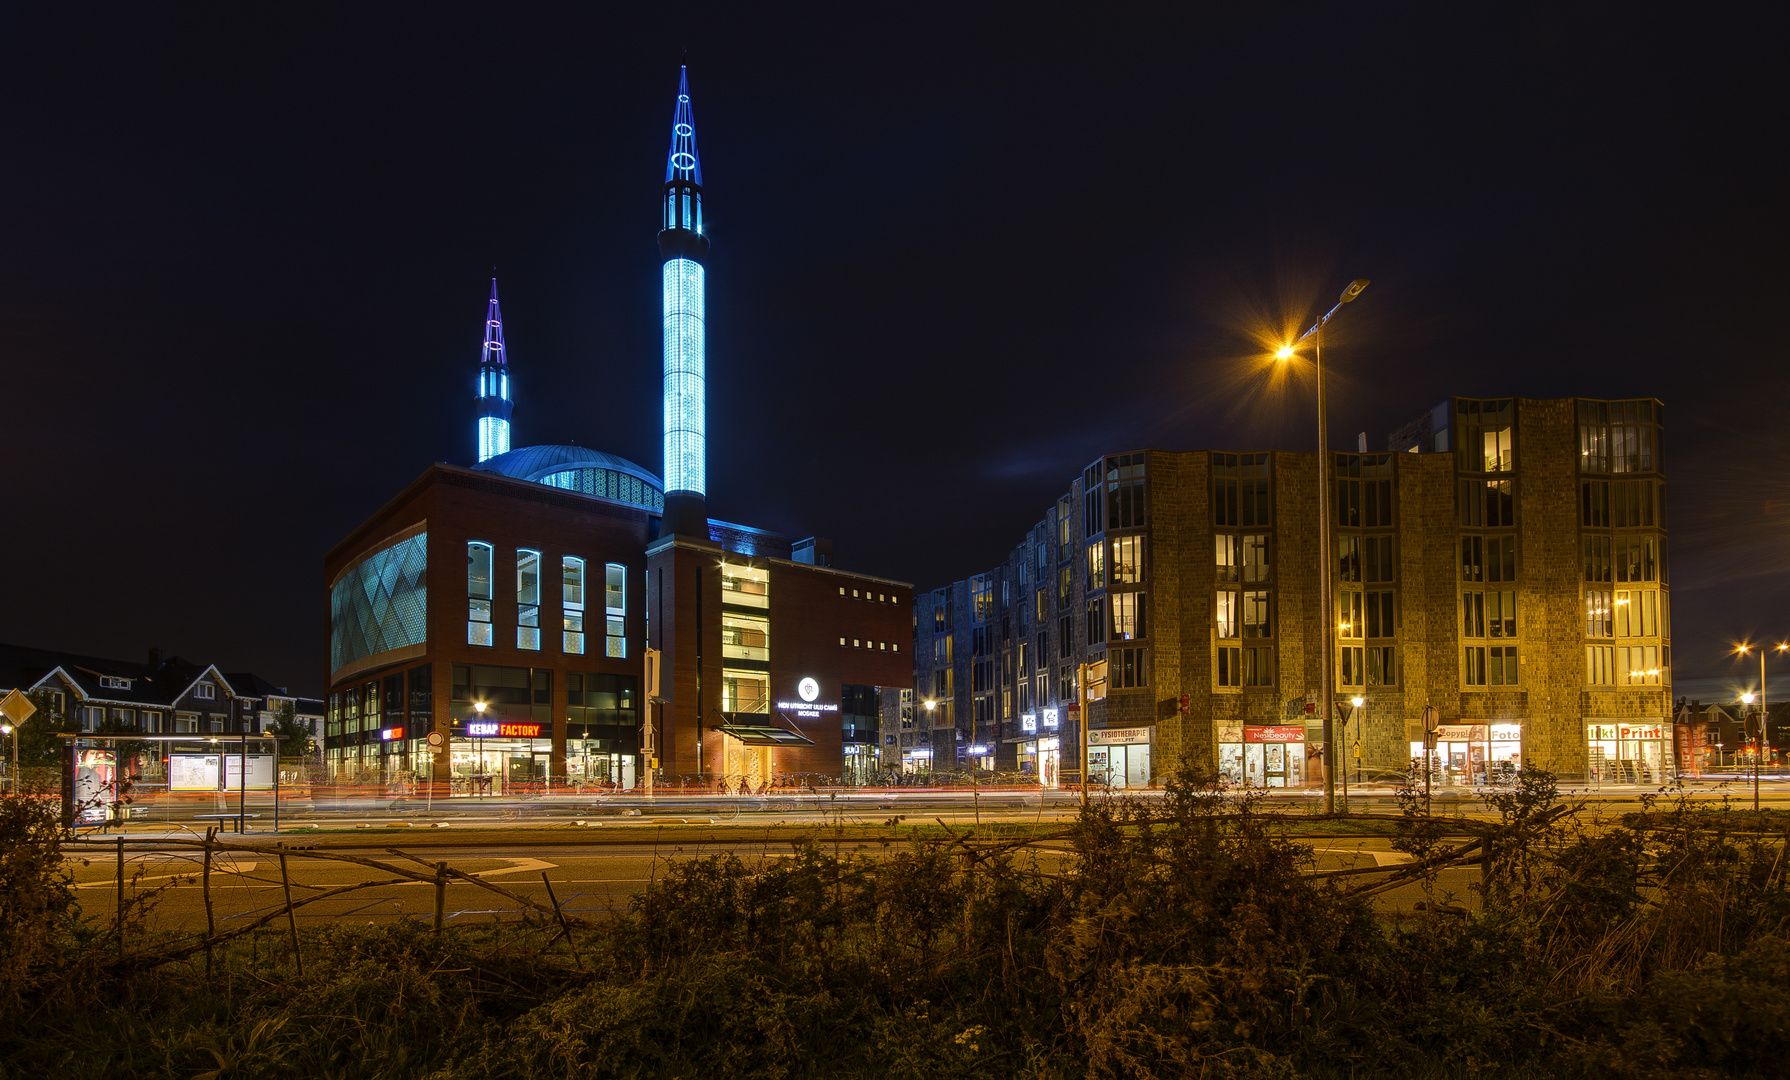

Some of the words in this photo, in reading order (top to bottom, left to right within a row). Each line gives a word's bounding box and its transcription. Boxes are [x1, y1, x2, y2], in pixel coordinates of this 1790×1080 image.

[790, 702, 812, 710] UTRECHT
[469, 723, 498, 735] KEBAP
[500, 725, 539, 736] FACTORY
[1101, 729, 1146, 738] FYSIOTHERAPIE
[1591, 729, 1614, 738] Ikt
[1620, 728, 1660, 738] Print
[1492, 730, 1520, 739] Foto
